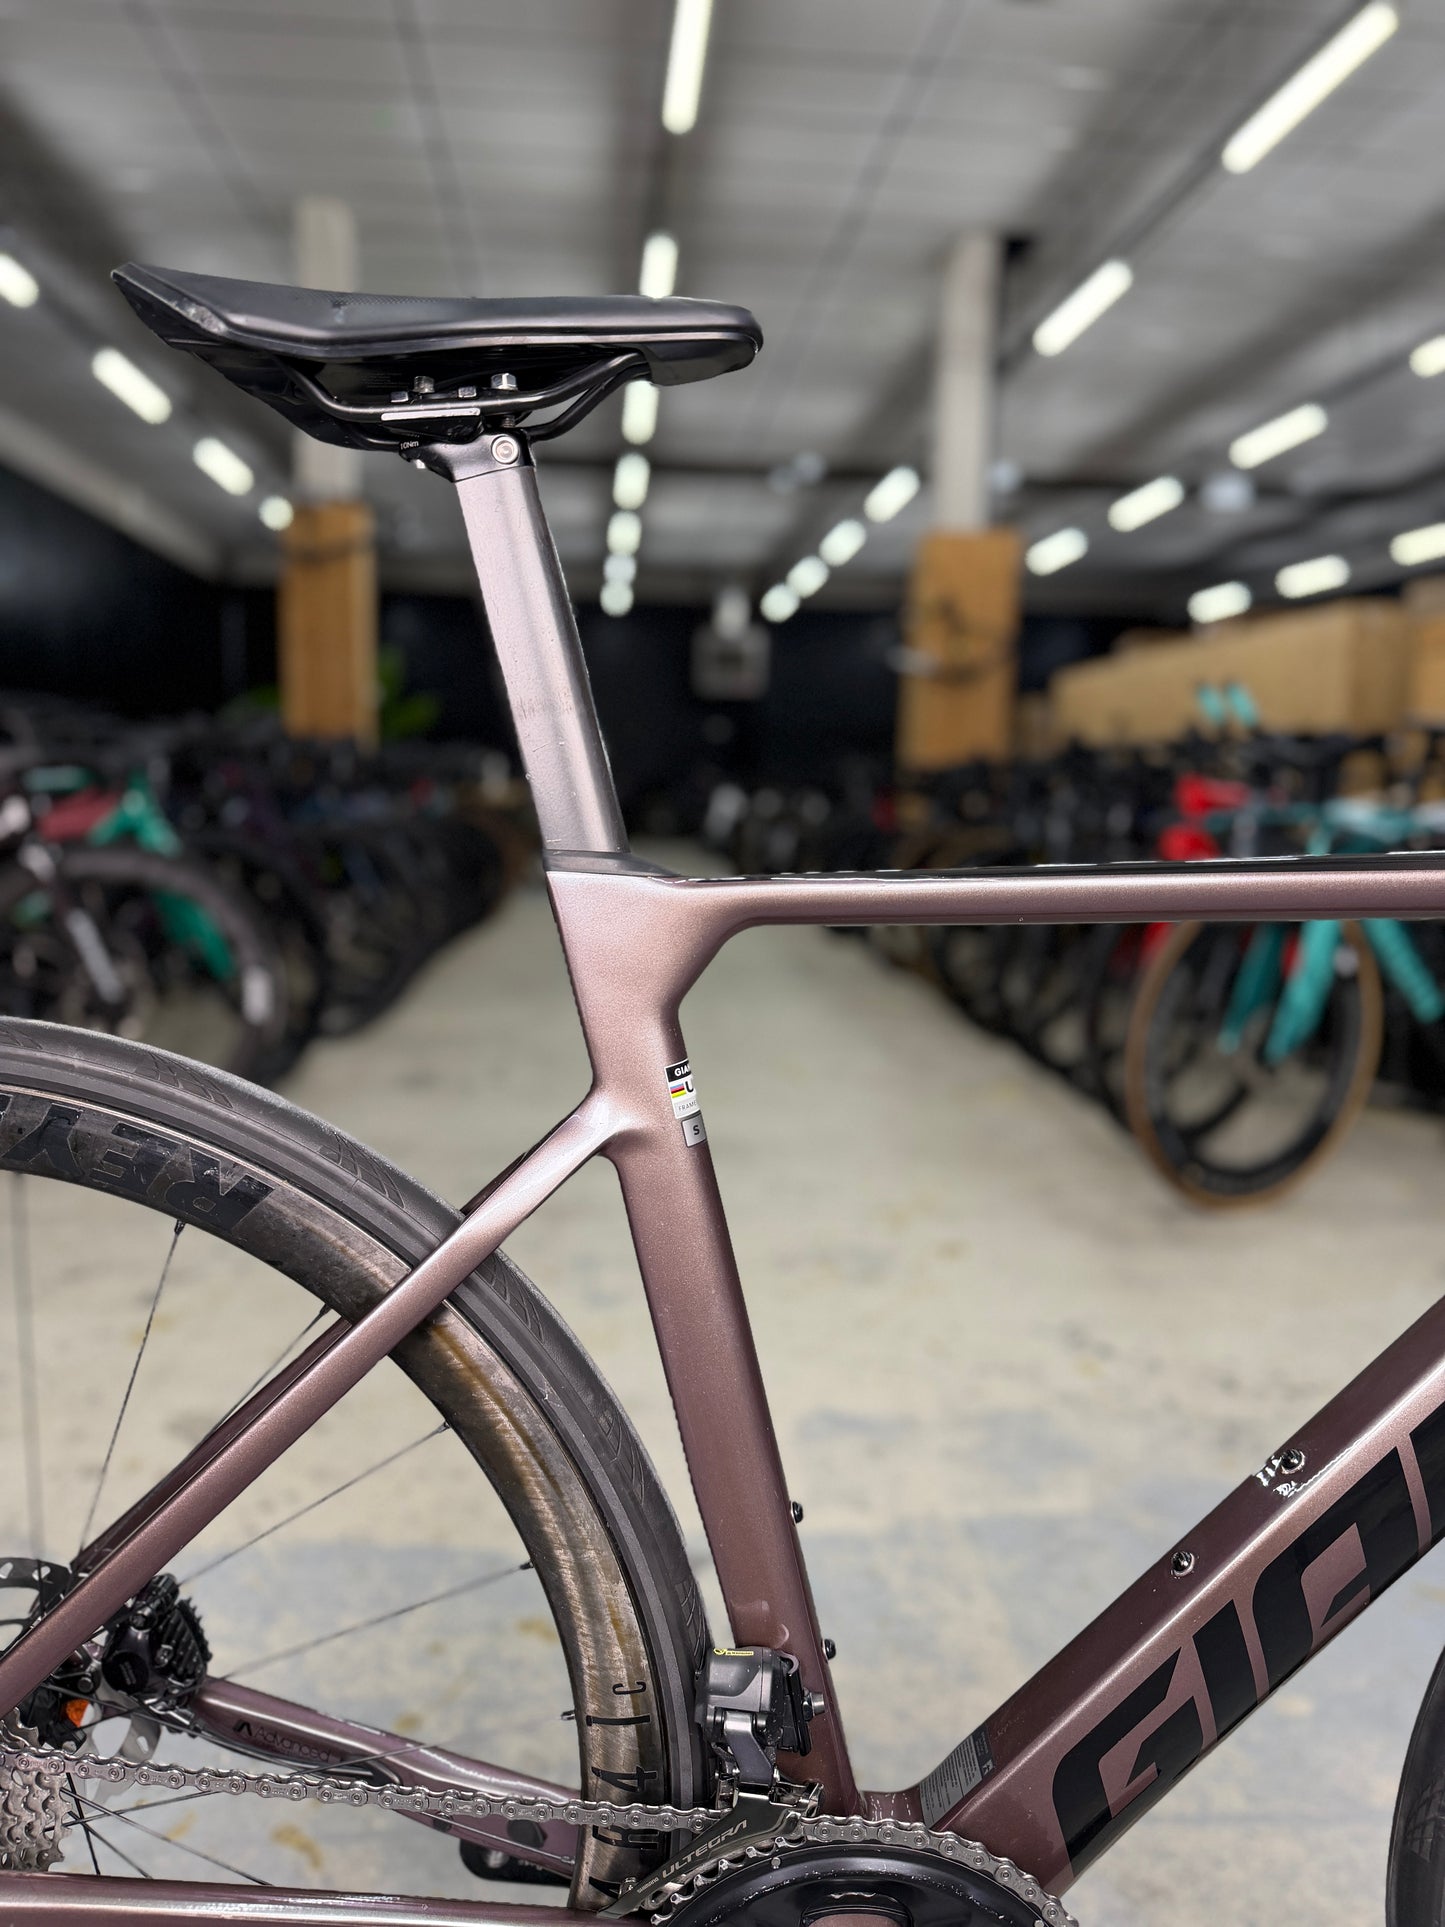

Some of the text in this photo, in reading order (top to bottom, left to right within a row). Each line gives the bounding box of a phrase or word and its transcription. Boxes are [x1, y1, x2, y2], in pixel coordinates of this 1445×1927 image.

[674, 1064, 690, 1077] GIA
[693, 1124, 700, 1135] S
[0, 1093, 275, 1235] REY
[1052, 1402, 1445, 1876] GIA
[254, 1726, 331, 1763] Advanced
[662, 1819, 748, 1879] ULTEGRA
